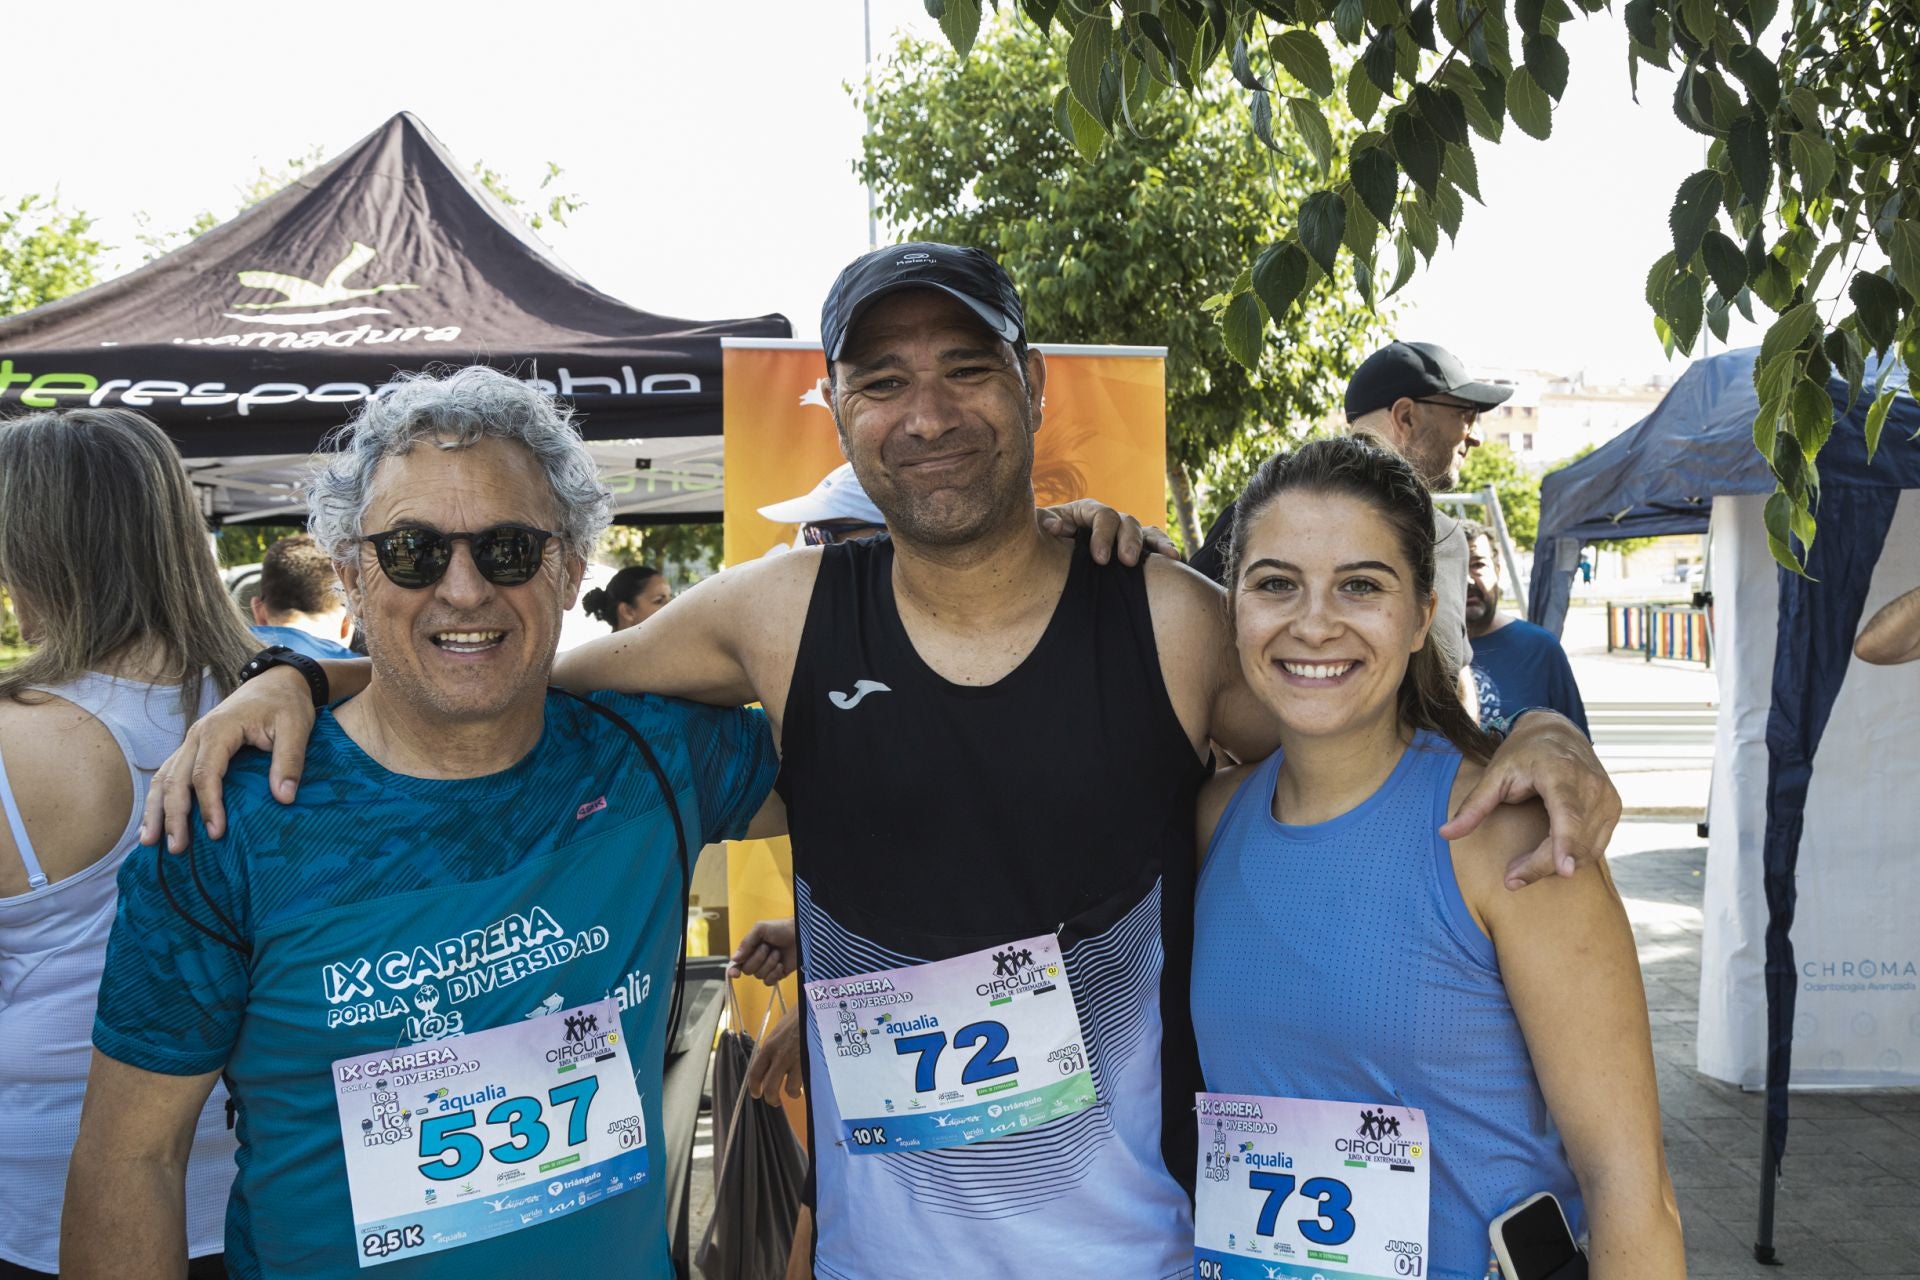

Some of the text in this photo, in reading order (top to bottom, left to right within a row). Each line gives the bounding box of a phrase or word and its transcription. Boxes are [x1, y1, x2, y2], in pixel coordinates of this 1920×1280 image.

[321, 906, 564, 1004] IX CARRERA
[328, 926, 609, 1029] POR LA DIVERSIDAD
[1803, 960, 1918, 979] CHROMA
[810, 978, 895, 1001] IX CARRERA
[1016, 980, 1051, 994] EXTREMADURA
[850, 991, 913, 1010] DIVERSIDAD
[406, 1010, 463, 1042] l@s
[886, 1014, 939, 1036] aqualia
[894, 1020, 1019, 1093] 72
[1047, 1043, 1080, 1062] JUNIO
[1059, 1052, 1084, 1075] 01
[338, 1047, 458, 1083] IX CARRERA
[393, 1060, 480, 1087] DIVERSIDAD
[440, 1084, 506, 1113] aqualia
[1212, 1101, 1263, 1119] CARRERA
[418, 1075, 599, 1182] 537
[607, 1115, 640, 1134] JUNIO
[853, 1126, 887, 1145] 10 K
[1225, 1120, 1277, 1134] DIVERSIDAD
[619, 1125, 642, 1149] 01
[1245, 1152, 1293, 1170] aqualia
[1374, 1156, 1411, 1165] EXTREMADURA
[1249, 1170, 1356, 1246] 73
[403, 1224, 424, 1248] K
[1385, 1239, 1422, 1255] JUNIO
[1199, 1260, 1222, 1280] 10 K
[1394, 1254, 1422, 1278] 01
